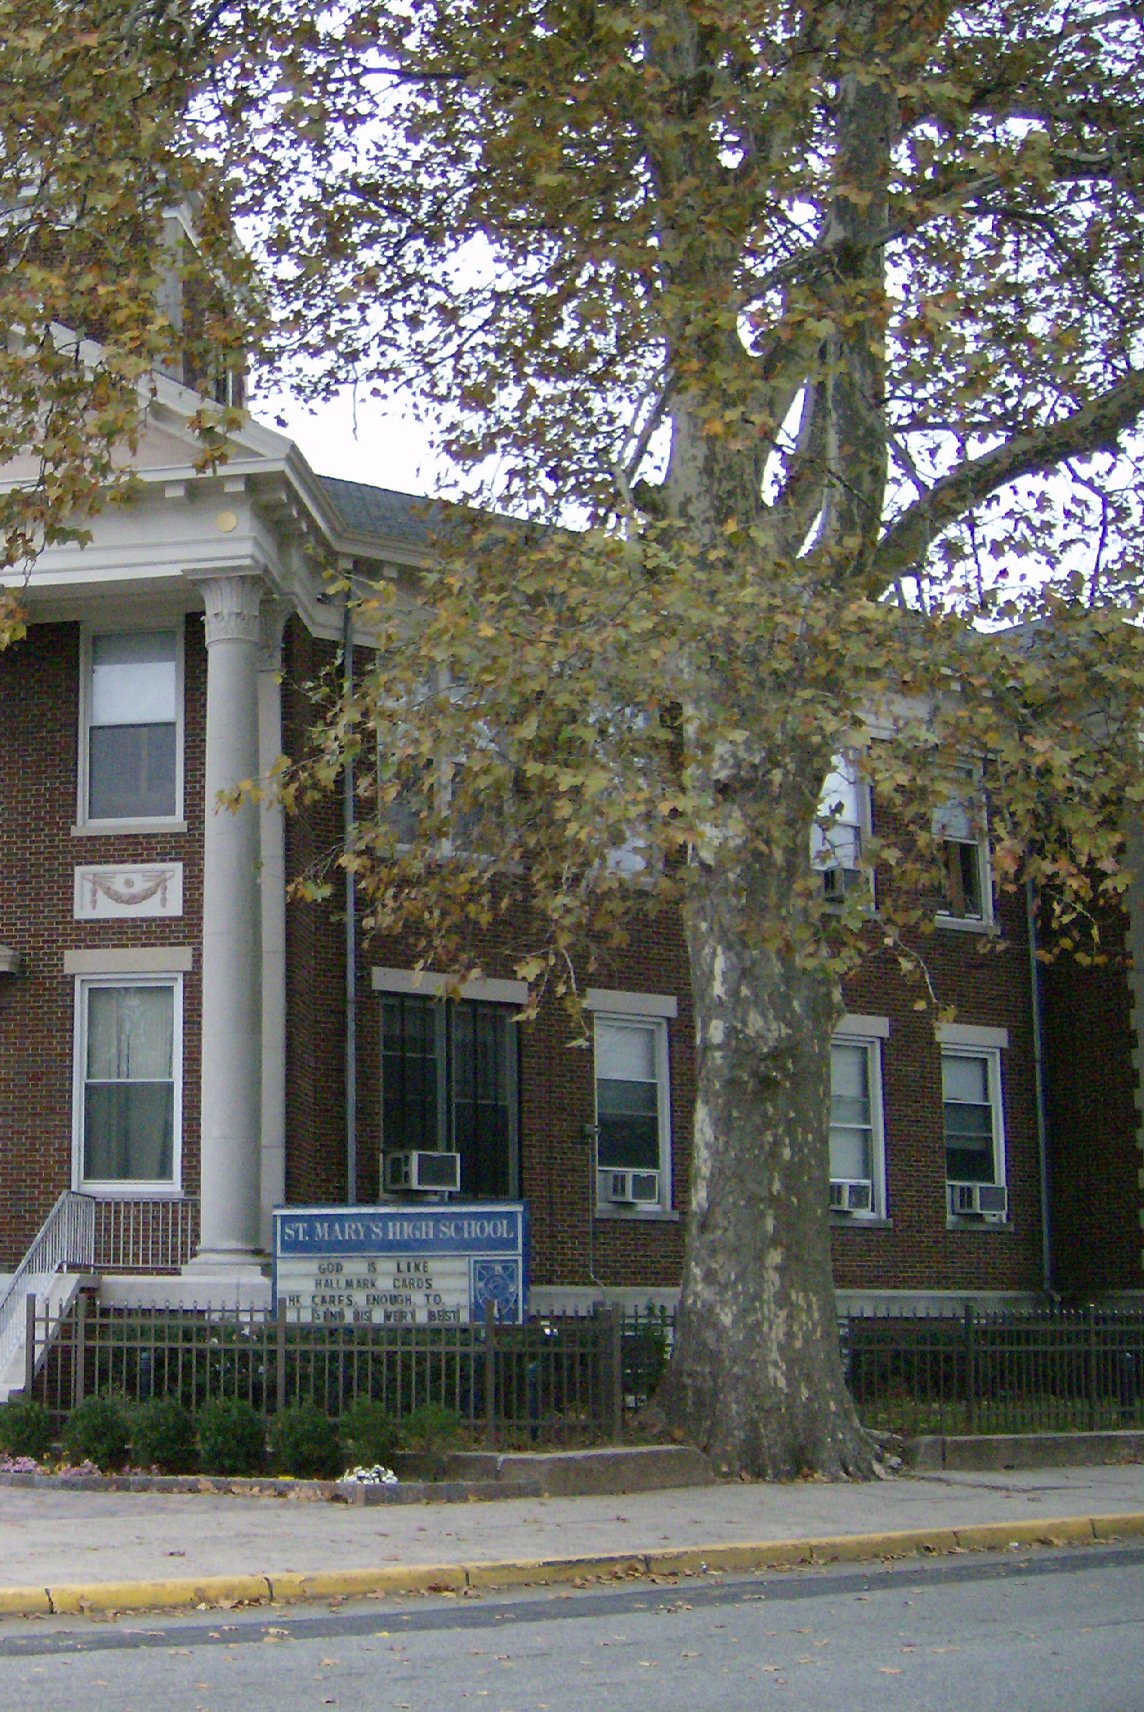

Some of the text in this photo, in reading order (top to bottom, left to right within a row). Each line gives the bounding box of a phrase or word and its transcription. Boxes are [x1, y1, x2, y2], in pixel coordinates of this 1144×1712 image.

[284, 1219, 514, 1241] ST. MARY'S HIGH SCHOOL
[317, 1261, 429, 1274] GOD IS LIKE
[314, 1278, 433, 1291] HALLMARK CARDS
[288, 1294, 301, 1307] HE
[311, 1294, 354, 1307] CARES
[365, 1293, 412, 1307] ENOUGH
